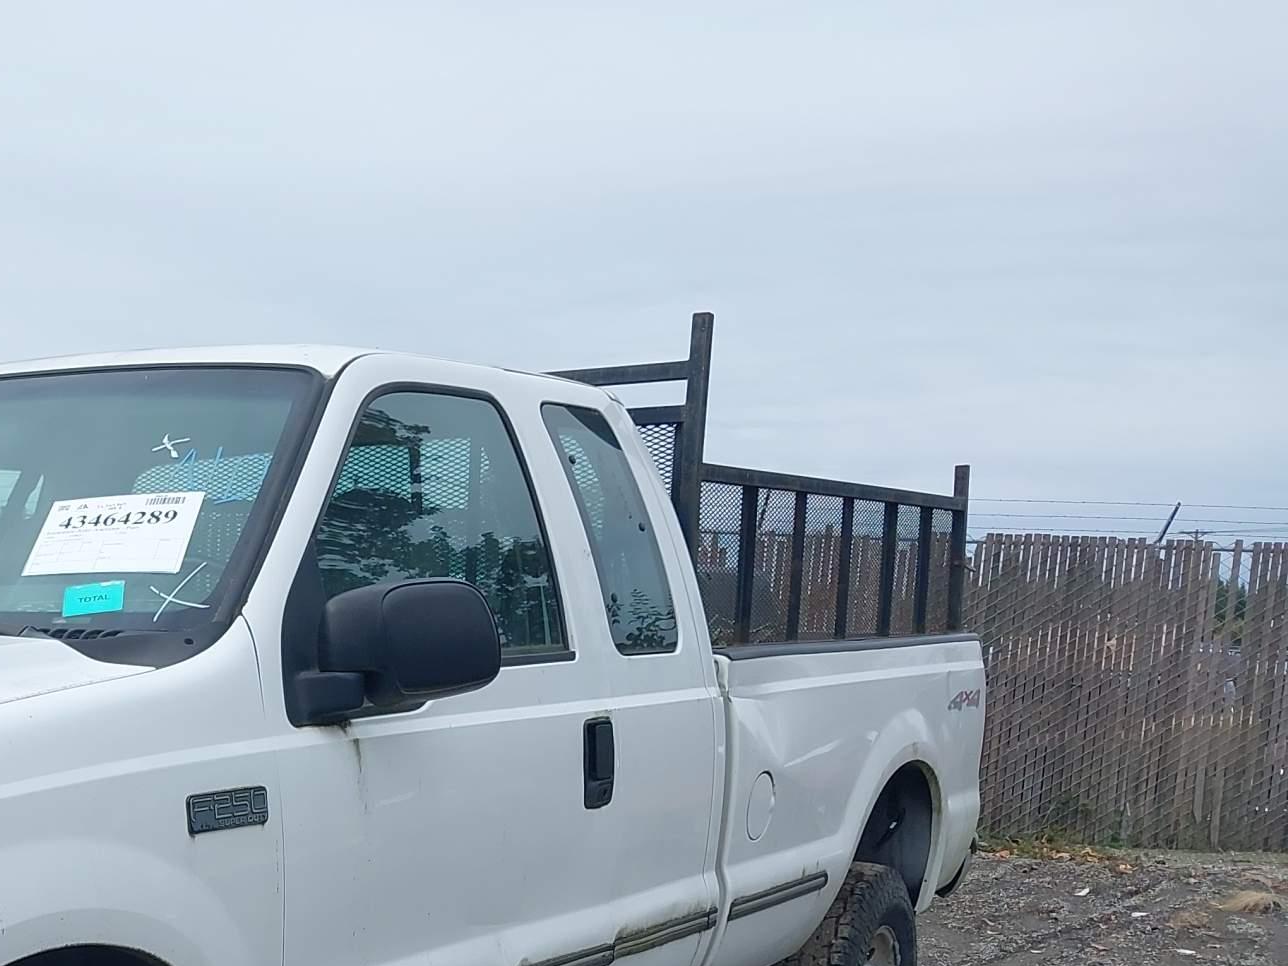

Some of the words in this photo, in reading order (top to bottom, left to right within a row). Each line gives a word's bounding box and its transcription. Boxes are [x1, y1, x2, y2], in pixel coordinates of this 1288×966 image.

[58, 509, 179, 529] 43464289
[78, 594, 111, 604] TOTAL
[217, 816, 249, 828] SUPER
[247, 812, 268, 823] DUTY
